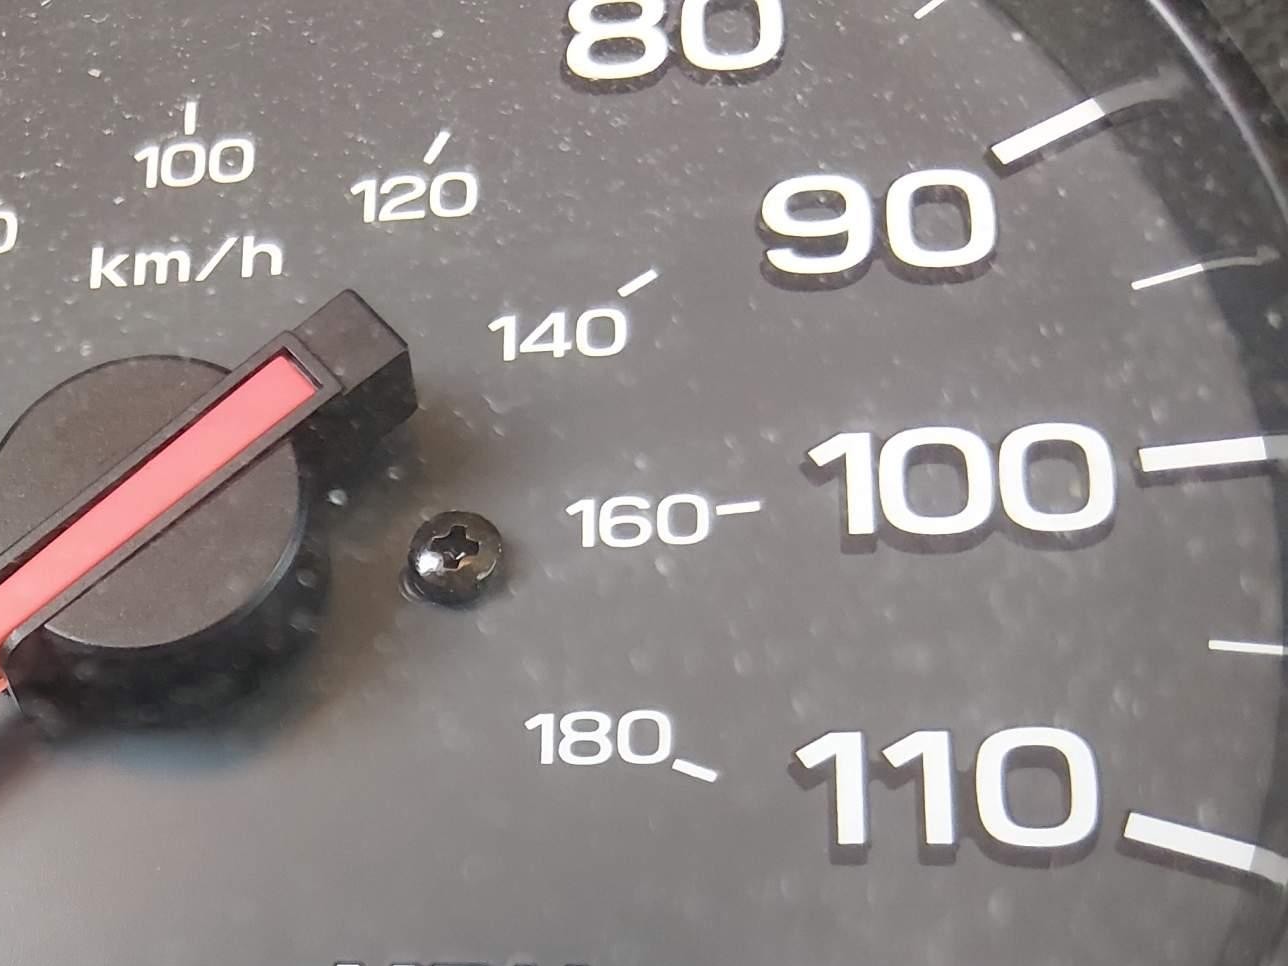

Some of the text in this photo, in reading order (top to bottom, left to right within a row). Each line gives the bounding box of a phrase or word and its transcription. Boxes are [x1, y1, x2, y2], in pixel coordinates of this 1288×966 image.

[566, 0, 784, 80] 80
[133, 138, 256, 189] 100
[350, 171, 479, 223] 120
[762, 168, 997, 274] 90
[88, 236, 285, 290] km/h
[488, 307, 628, 361] 140
[807, 423, 1115, 535] 100
[565, 494, 711, 548] 160
[524, 709, 673, 765] 180
[795, 726, 1099, 848] 110
